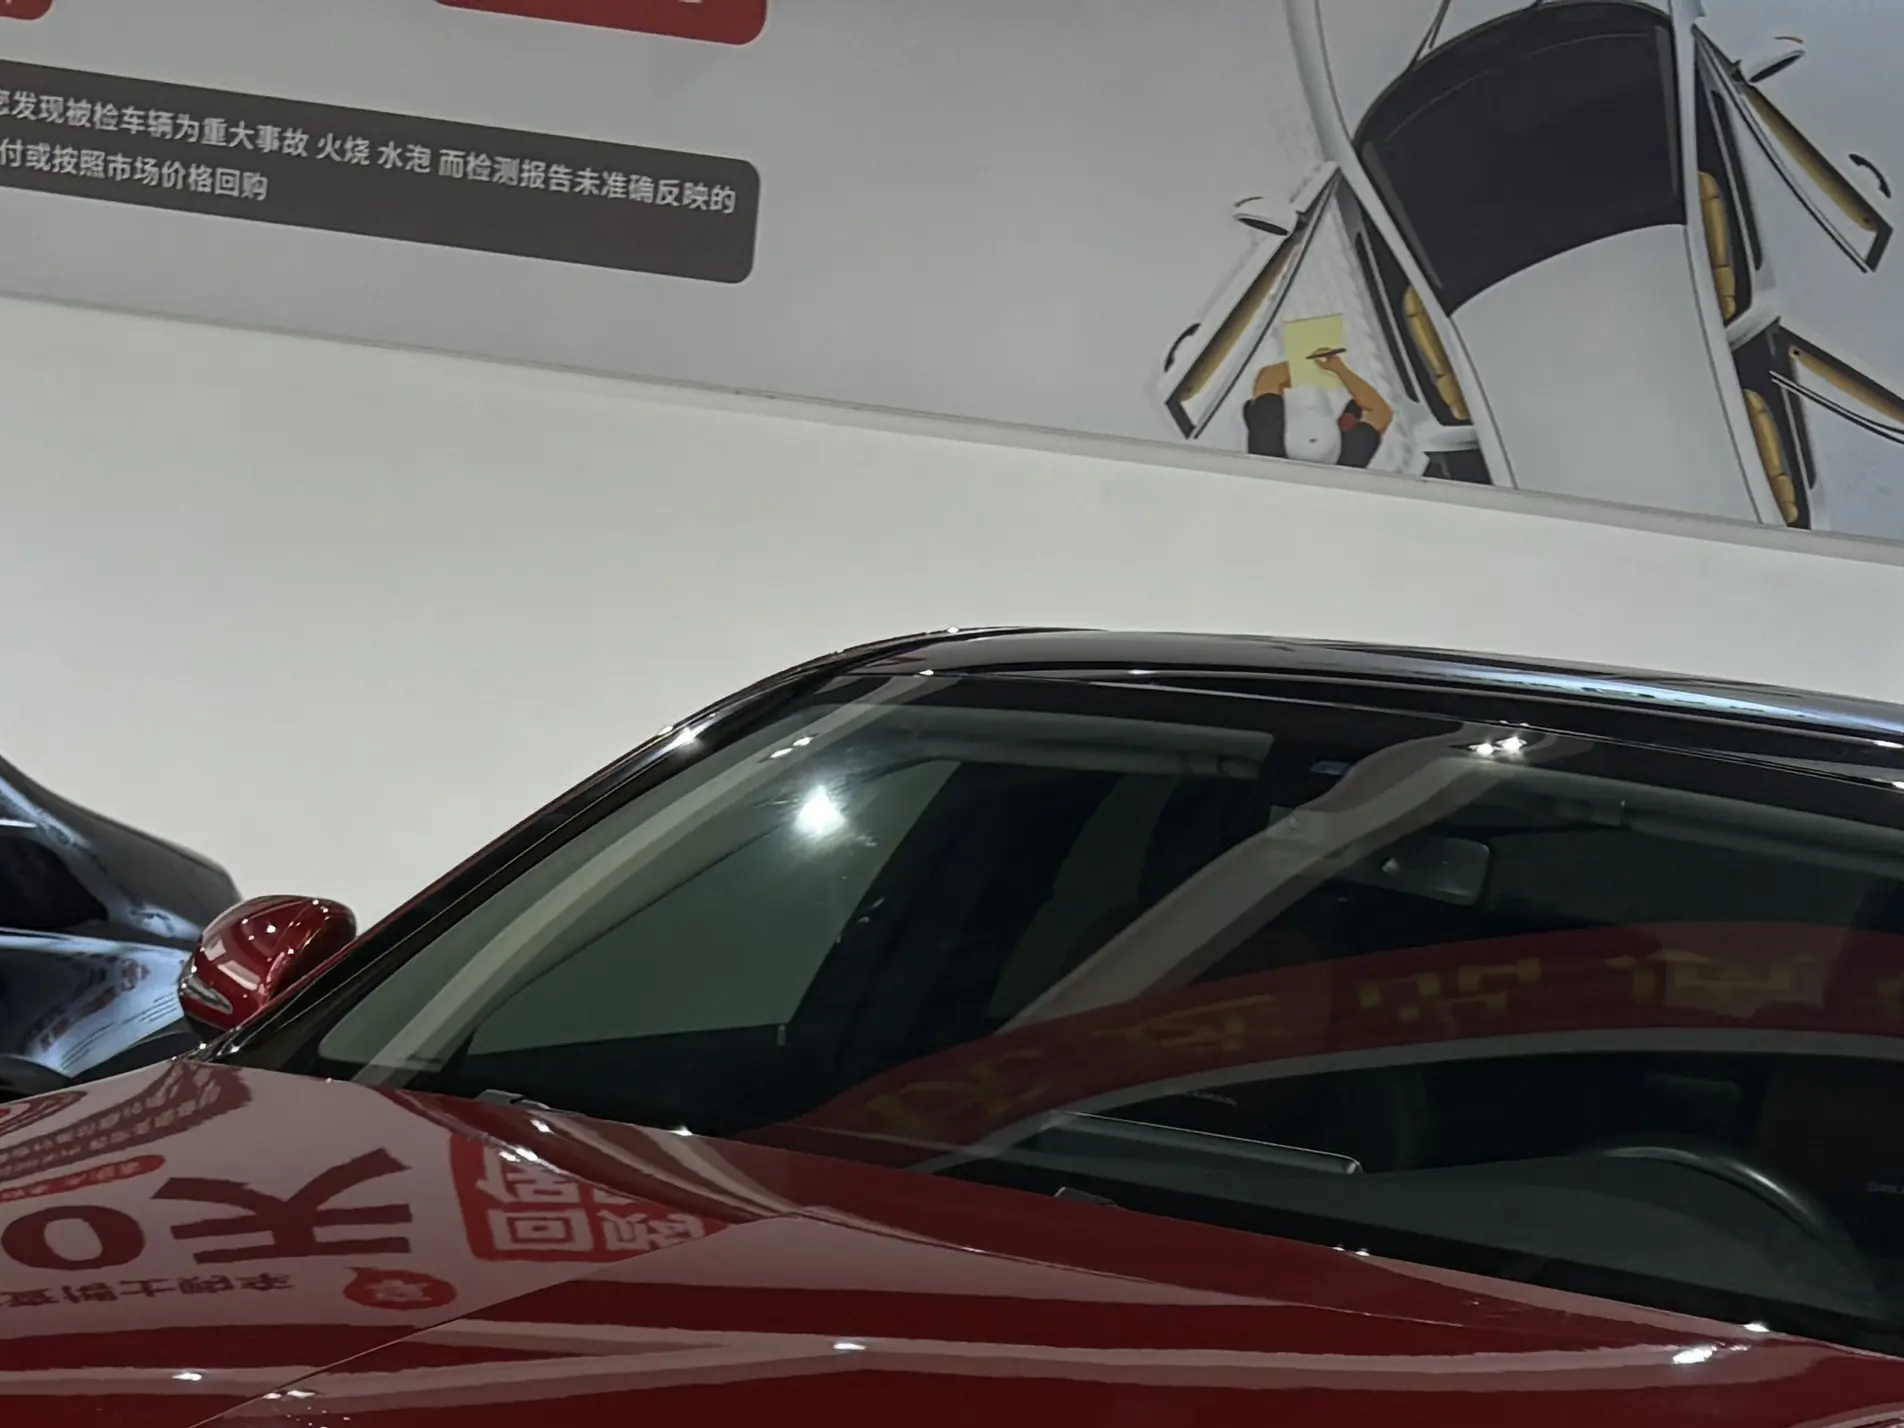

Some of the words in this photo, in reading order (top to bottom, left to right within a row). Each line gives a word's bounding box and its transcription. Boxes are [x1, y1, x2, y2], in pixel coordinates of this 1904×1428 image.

[316, 132, 371, 167] 火烧
[377, 140, 432, 175] 水泡
[438, 149, 737, 214] 而检测报告未准确反映的
